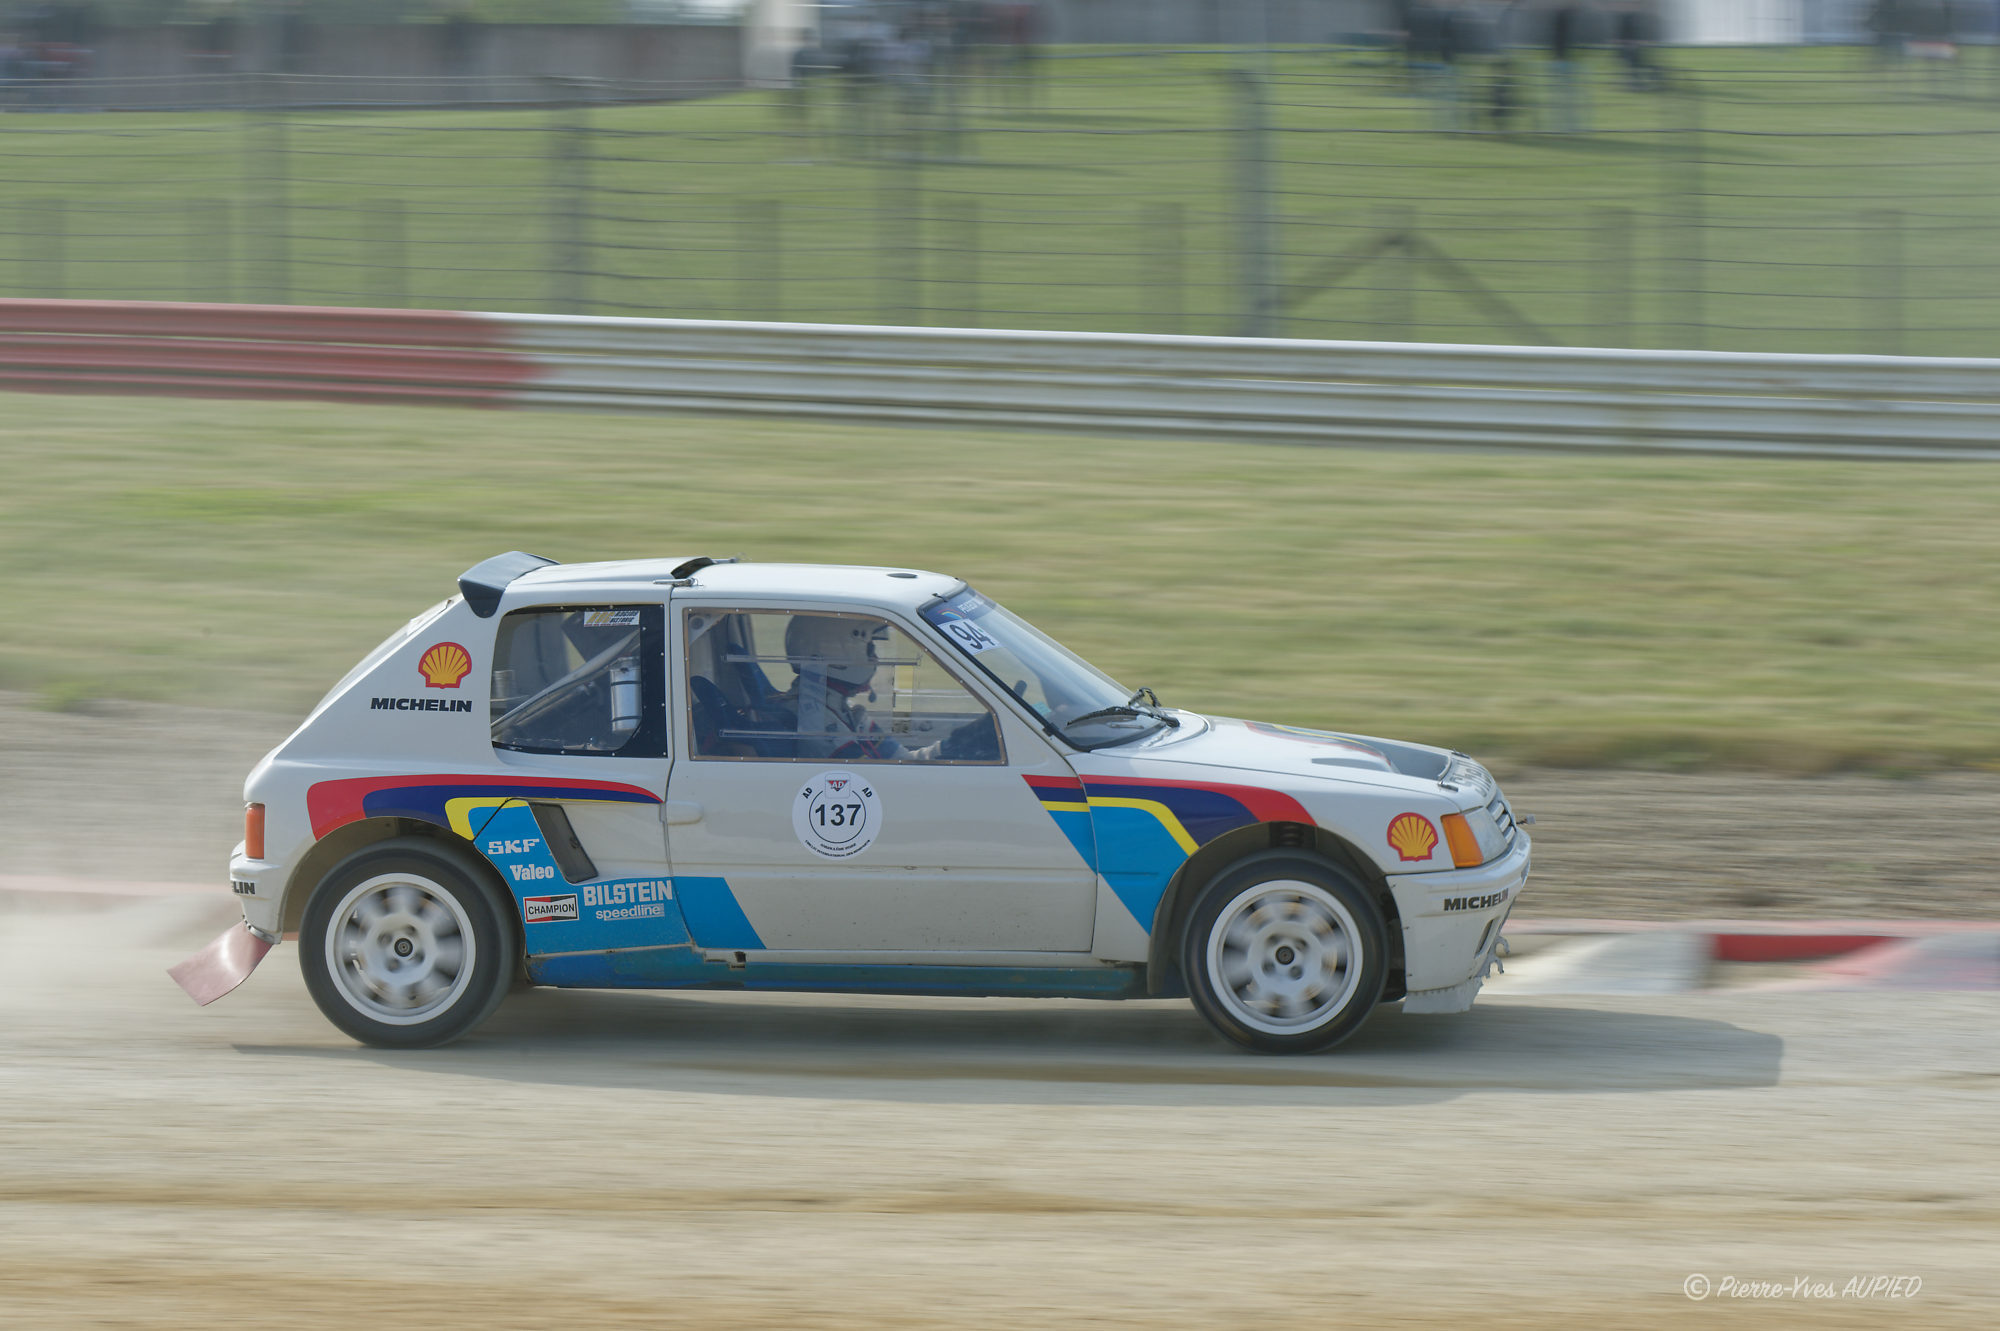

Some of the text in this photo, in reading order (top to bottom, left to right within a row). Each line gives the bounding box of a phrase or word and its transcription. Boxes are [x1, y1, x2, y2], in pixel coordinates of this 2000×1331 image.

[949, 621, 996, 650] 94
[370, 697, 472, 712] MICHELIN
[802, 787, 813, 799] AD
[861, 787, 873, 799] AD
[815, 803, 862, 827] 137
[488, 838, 540, 855] SKF
[509, 864, 555, 881] Valeo
[583, 880, 673, 906] BILSTEIN
[528, 903, 575, 916] CHAMPION
[595, 904, 661, 921] speedline
